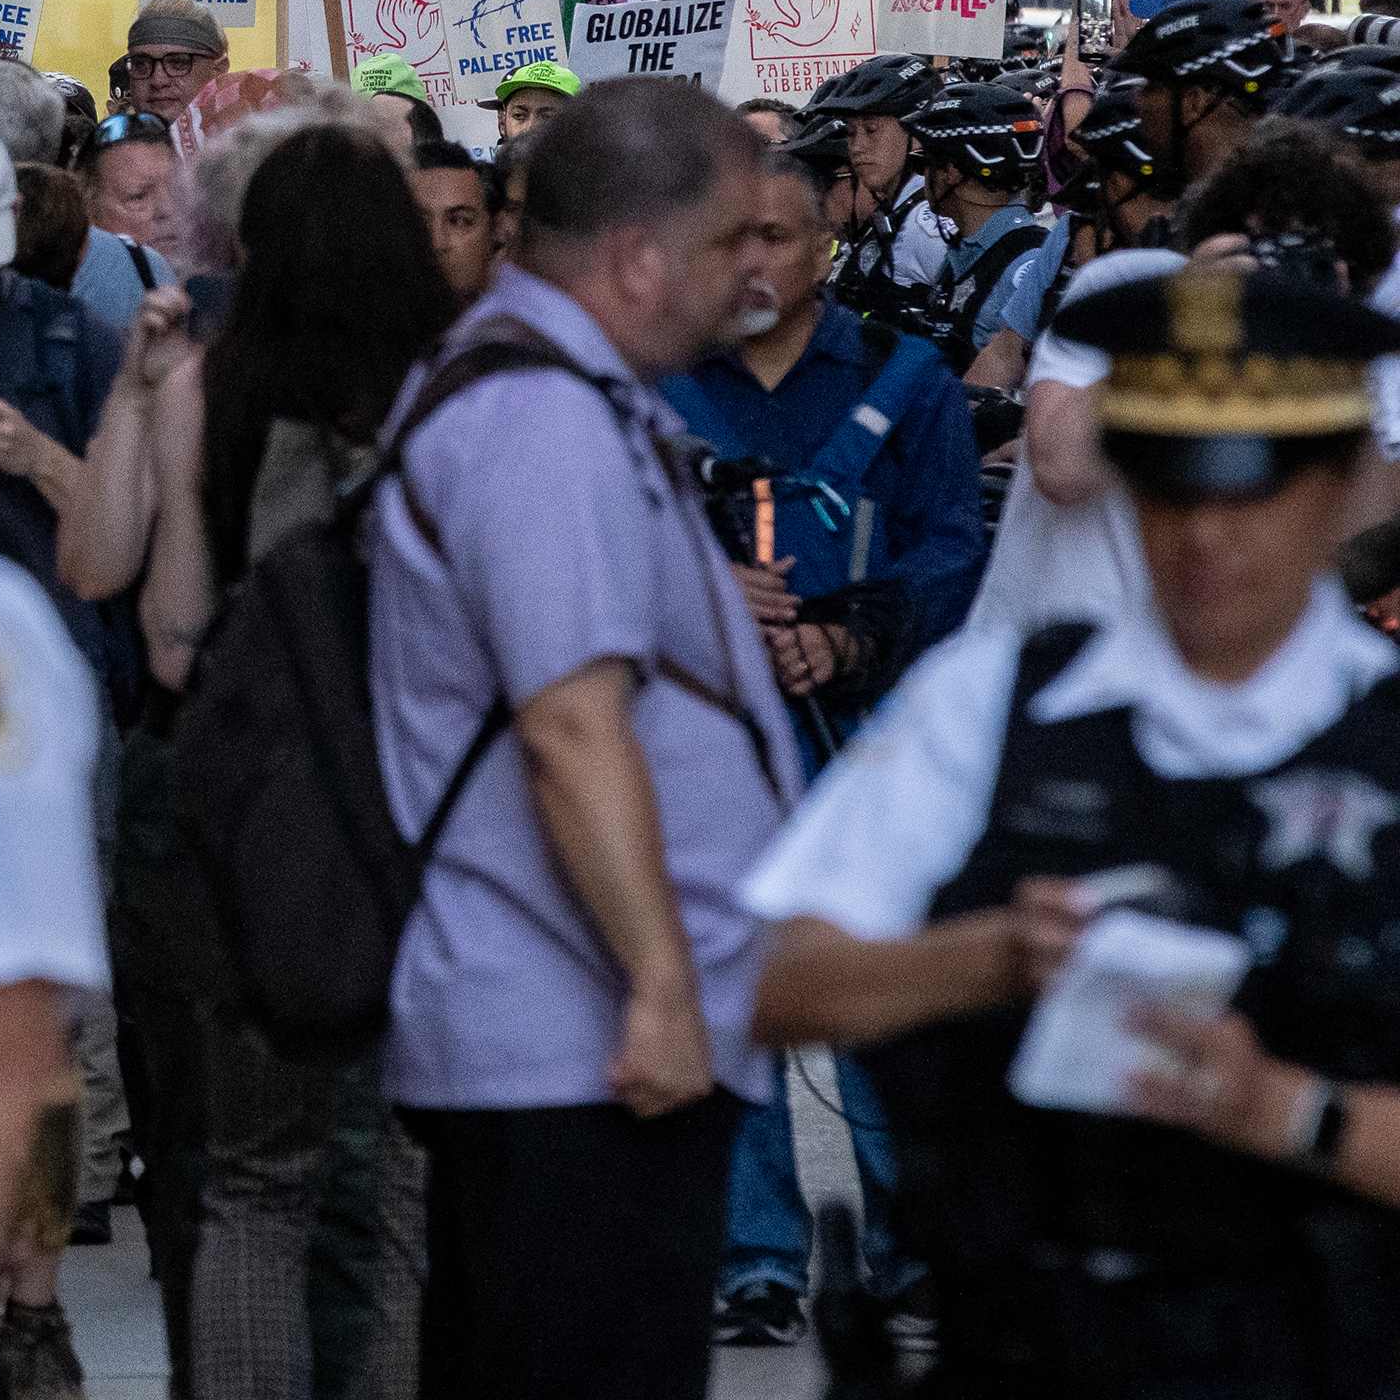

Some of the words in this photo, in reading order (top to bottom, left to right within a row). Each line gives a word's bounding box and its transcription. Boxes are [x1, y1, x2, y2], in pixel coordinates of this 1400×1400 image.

[506, 22, 554, 45] FREE
[586, 1, 726, 44] GLOBALIZE
[459, 46, 558, 76] PALESTINE
[628, 41, 677, 73] THE
[899, 61, 926, 80] POLICE
[763, 75, 824, 93] LIBERA
